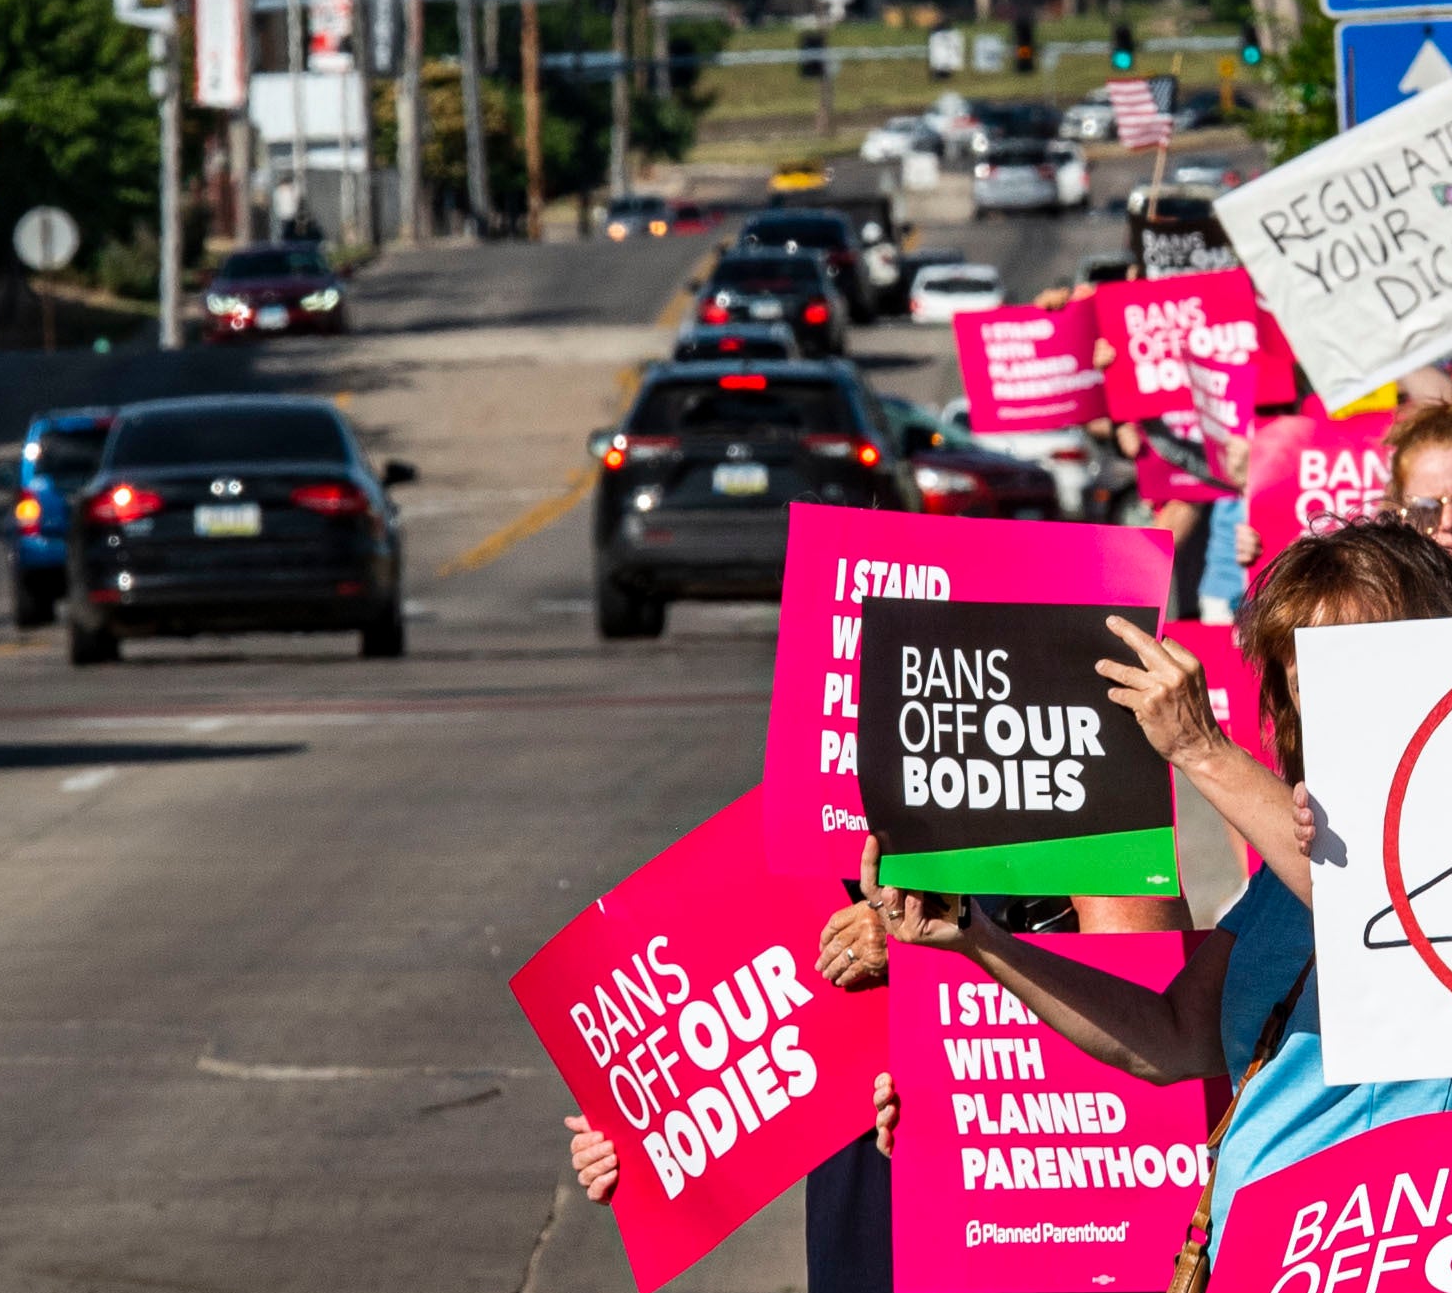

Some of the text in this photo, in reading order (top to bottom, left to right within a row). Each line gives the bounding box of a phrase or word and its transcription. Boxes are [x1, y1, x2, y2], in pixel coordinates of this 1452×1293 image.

[1295, 207, 1428, 295] YOUR
[1124, 297, 1207, 337] BANS
[1128, 320, 1259, 364] OFF OUR
[1300, 449, 1395, 490] BAN
[835, 557, 951, 604] I STAND
[901, 645, 1011, 701] BANS
[899, 700, 978, 754] OFF
[984, 703, 1106, 757] OUR
[902, 756, 1086, 811] BODIES
[570, 935, 690, 1069] BANS
[939, 982, 1041, 1026] I STA
[609, 945, 814, 1131] OFF OUR
[943, 1038, 1046, 1081] WITH
[642, 1024, 818, 1201] BODIES
[951, 1092, 1127, 1135] PLANNED
[983, 1222, 1041, 1244] Planned
